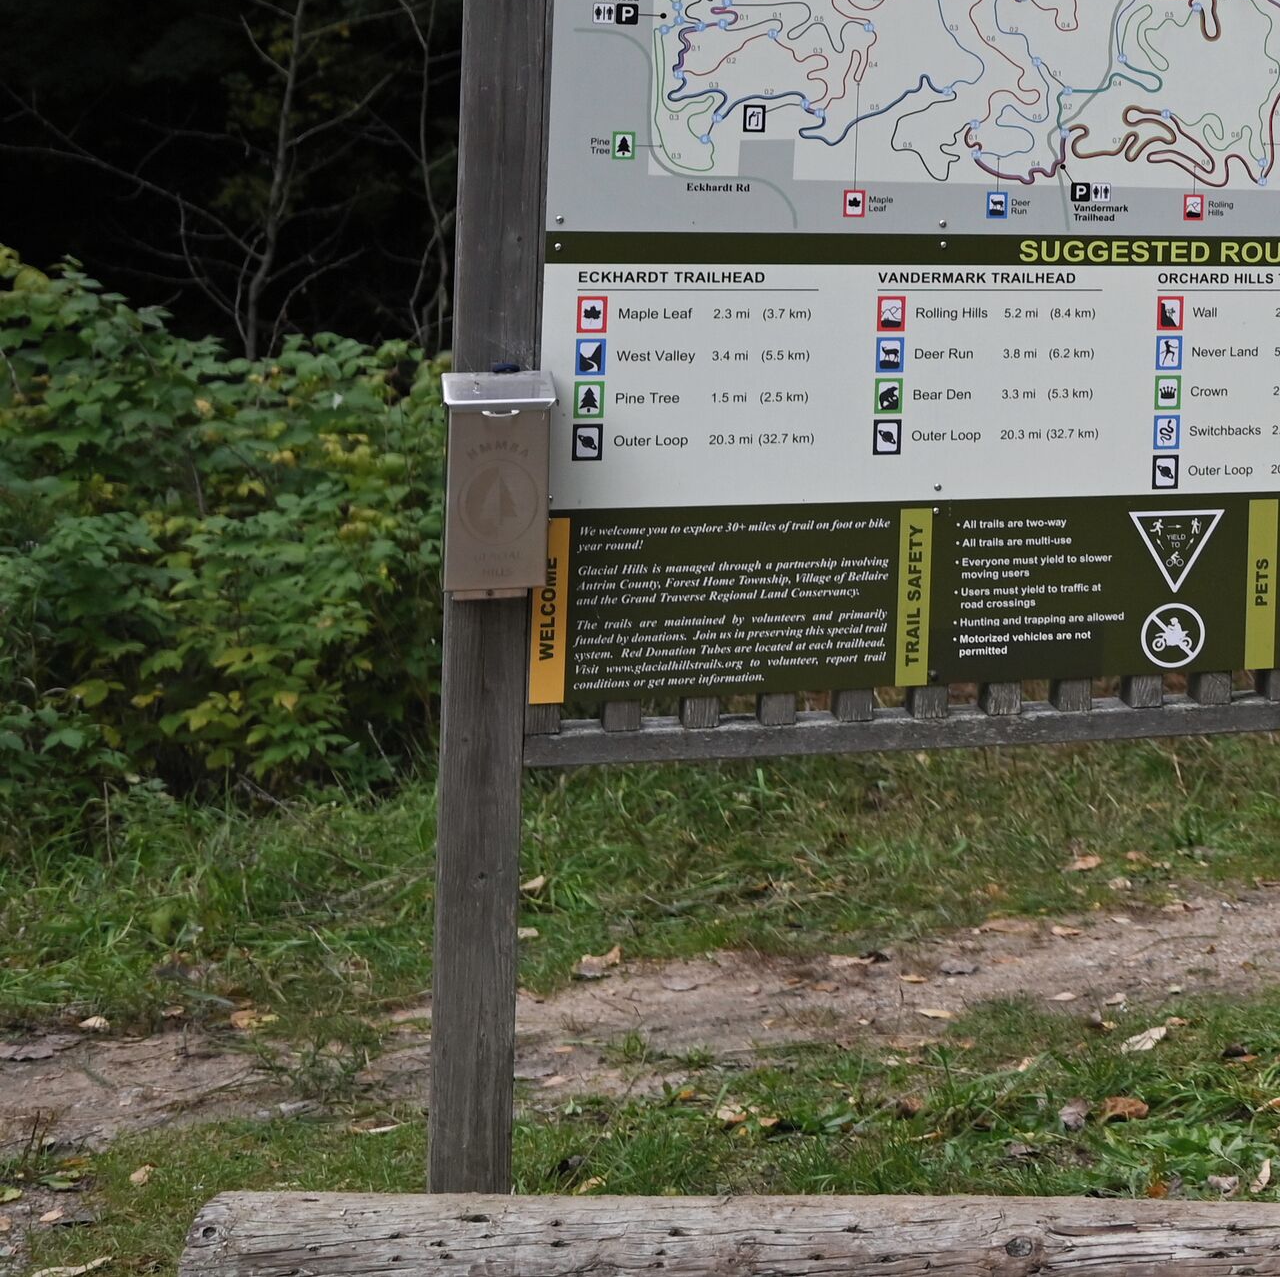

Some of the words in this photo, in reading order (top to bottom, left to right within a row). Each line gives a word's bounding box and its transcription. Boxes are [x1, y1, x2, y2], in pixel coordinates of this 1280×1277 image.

[686, 183, 732, 192] Eckhardt
[735, 183, 750, 192] Rd
[1074, 204, 1128, 212] Vandermark
[1072, 212, 1117, 224] Trailhead
[1020, 241, 1209, 262] SUGGESTED
[578, 271, 669, 283] ECKHARDT
[674, 271, 765, 283] TRAILHEAD
[878, 272, 986, 283] VANDERMARK
[991, 272, 1076, 284] TRAILHEAD
[1158, 273, 1229, 284] ORCHARD
[1234, 273, 1274, 284] HILLS
[618, 308, 659, 322] Maple
[663, 307, 693, 319] Leaf
[713, 308, 732, 319] 2.3
[736, 308, 750, 319] mi
[763, 308, 785, 322] (3.7
[789, 308, 811, 321] km)
[916, 307, 958, 321] Rolling
[962, 307, 988, 318] Hills
[963, 520, 977, 529] All
[979, 519, 1005, 529] trails
[1007, 519, 1024, 529] are
[1026, 517, 1068, 530] two-way
[907, 525, 923, 601] SAFETY
[1255, 559, 1269, 606] PETS
[538, 557, 558, 661] WELCOME
[905, 607, 920, 667] TRAIL
